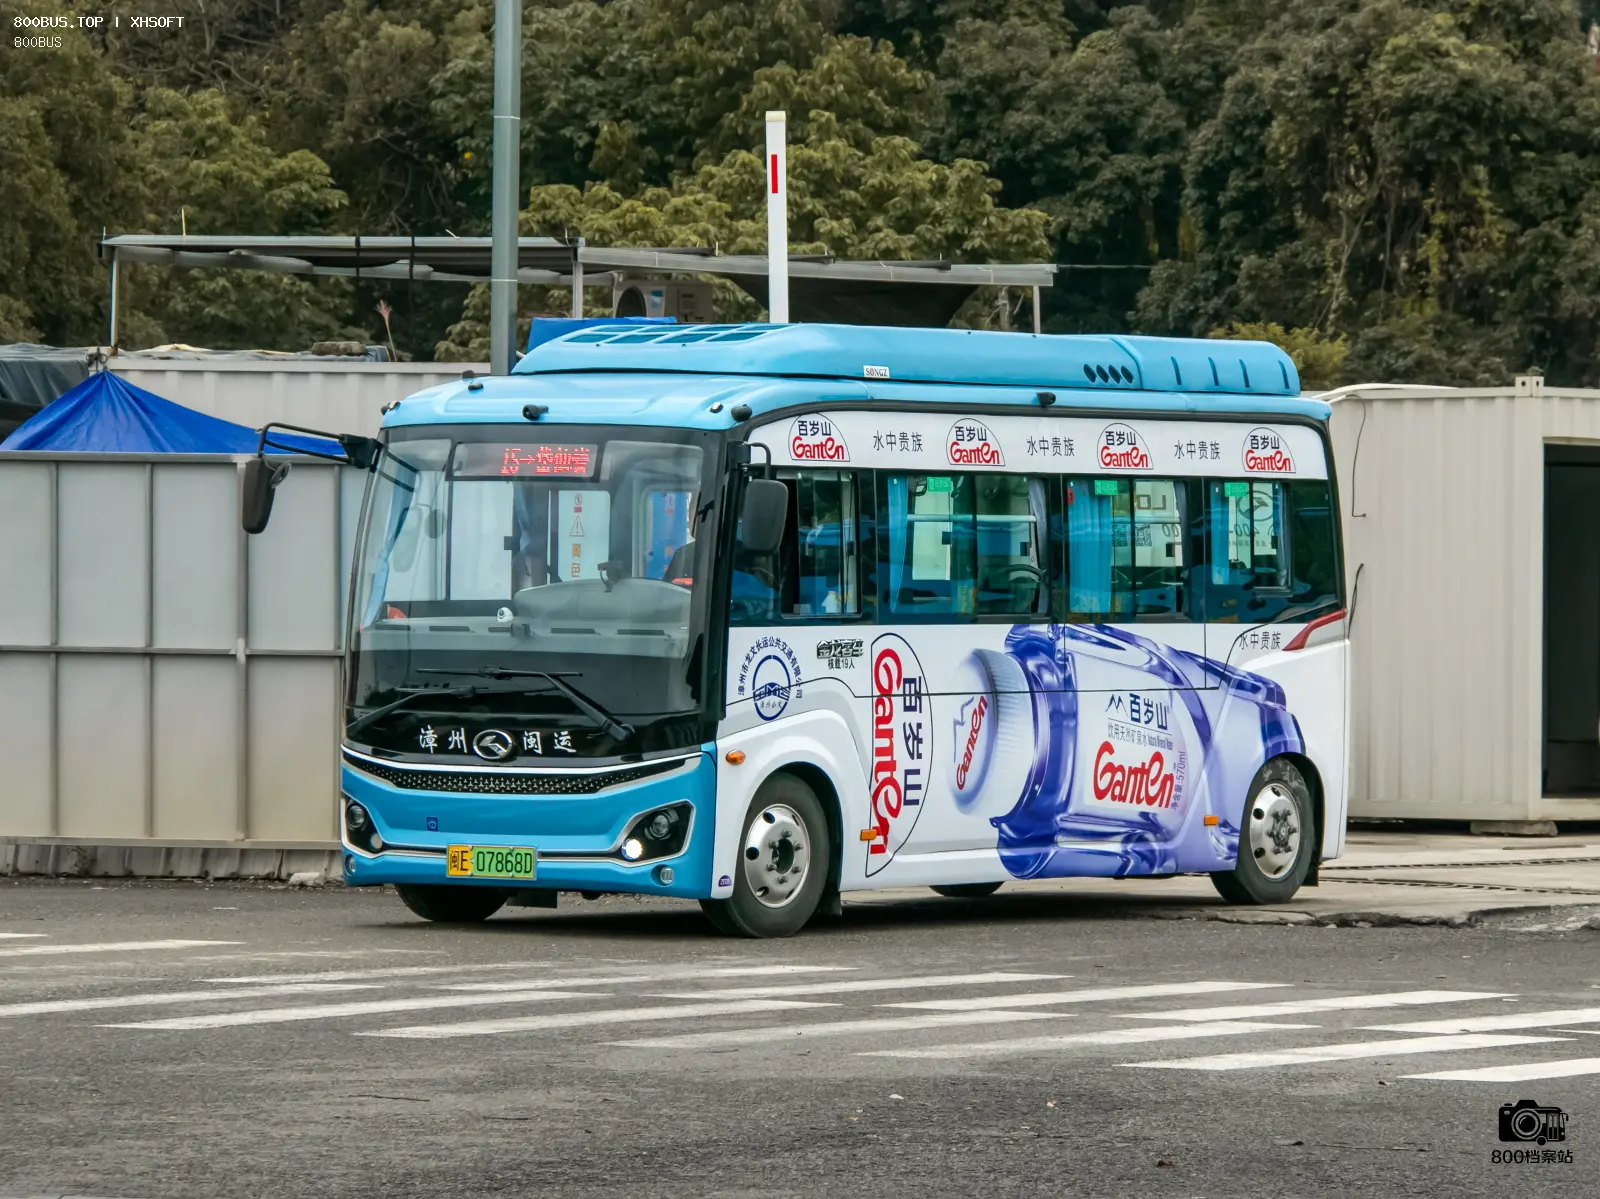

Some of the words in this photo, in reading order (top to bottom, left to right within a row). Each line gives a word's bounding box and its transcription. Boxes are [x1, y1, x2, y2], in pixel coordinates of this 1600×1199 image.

[865, 367, 888, 377] SONGZ
[797, 420, 832, 437] 百岁山
[954, 426, 987, 442] 百岁山
[1105, 431, 1136, 446] 百岁山
[873, 430, 923, 452] 水中贵族
[1027, 436, 1075, 457] 水中贵族
[1174, 440, 1221, 460] 水中贵族
[1249, 435, 1280, 450] 百岁山
[816, 639, 864, 659] 金龙客车
[1239, 630, 1281, 650] 水中贵族
[828, 658, 855, 669] 核载19人
[1129, 693, 1168, 731] 百岁山
[419, 725, 468, 753] 漳州
[523, 730, 577, 755] 闽运
[902, 676, 923, 806] 百岁山
[1107, 722, 1149, 747] 饮用天然矿泉水
[476, 851, 533, 874] 07868D
